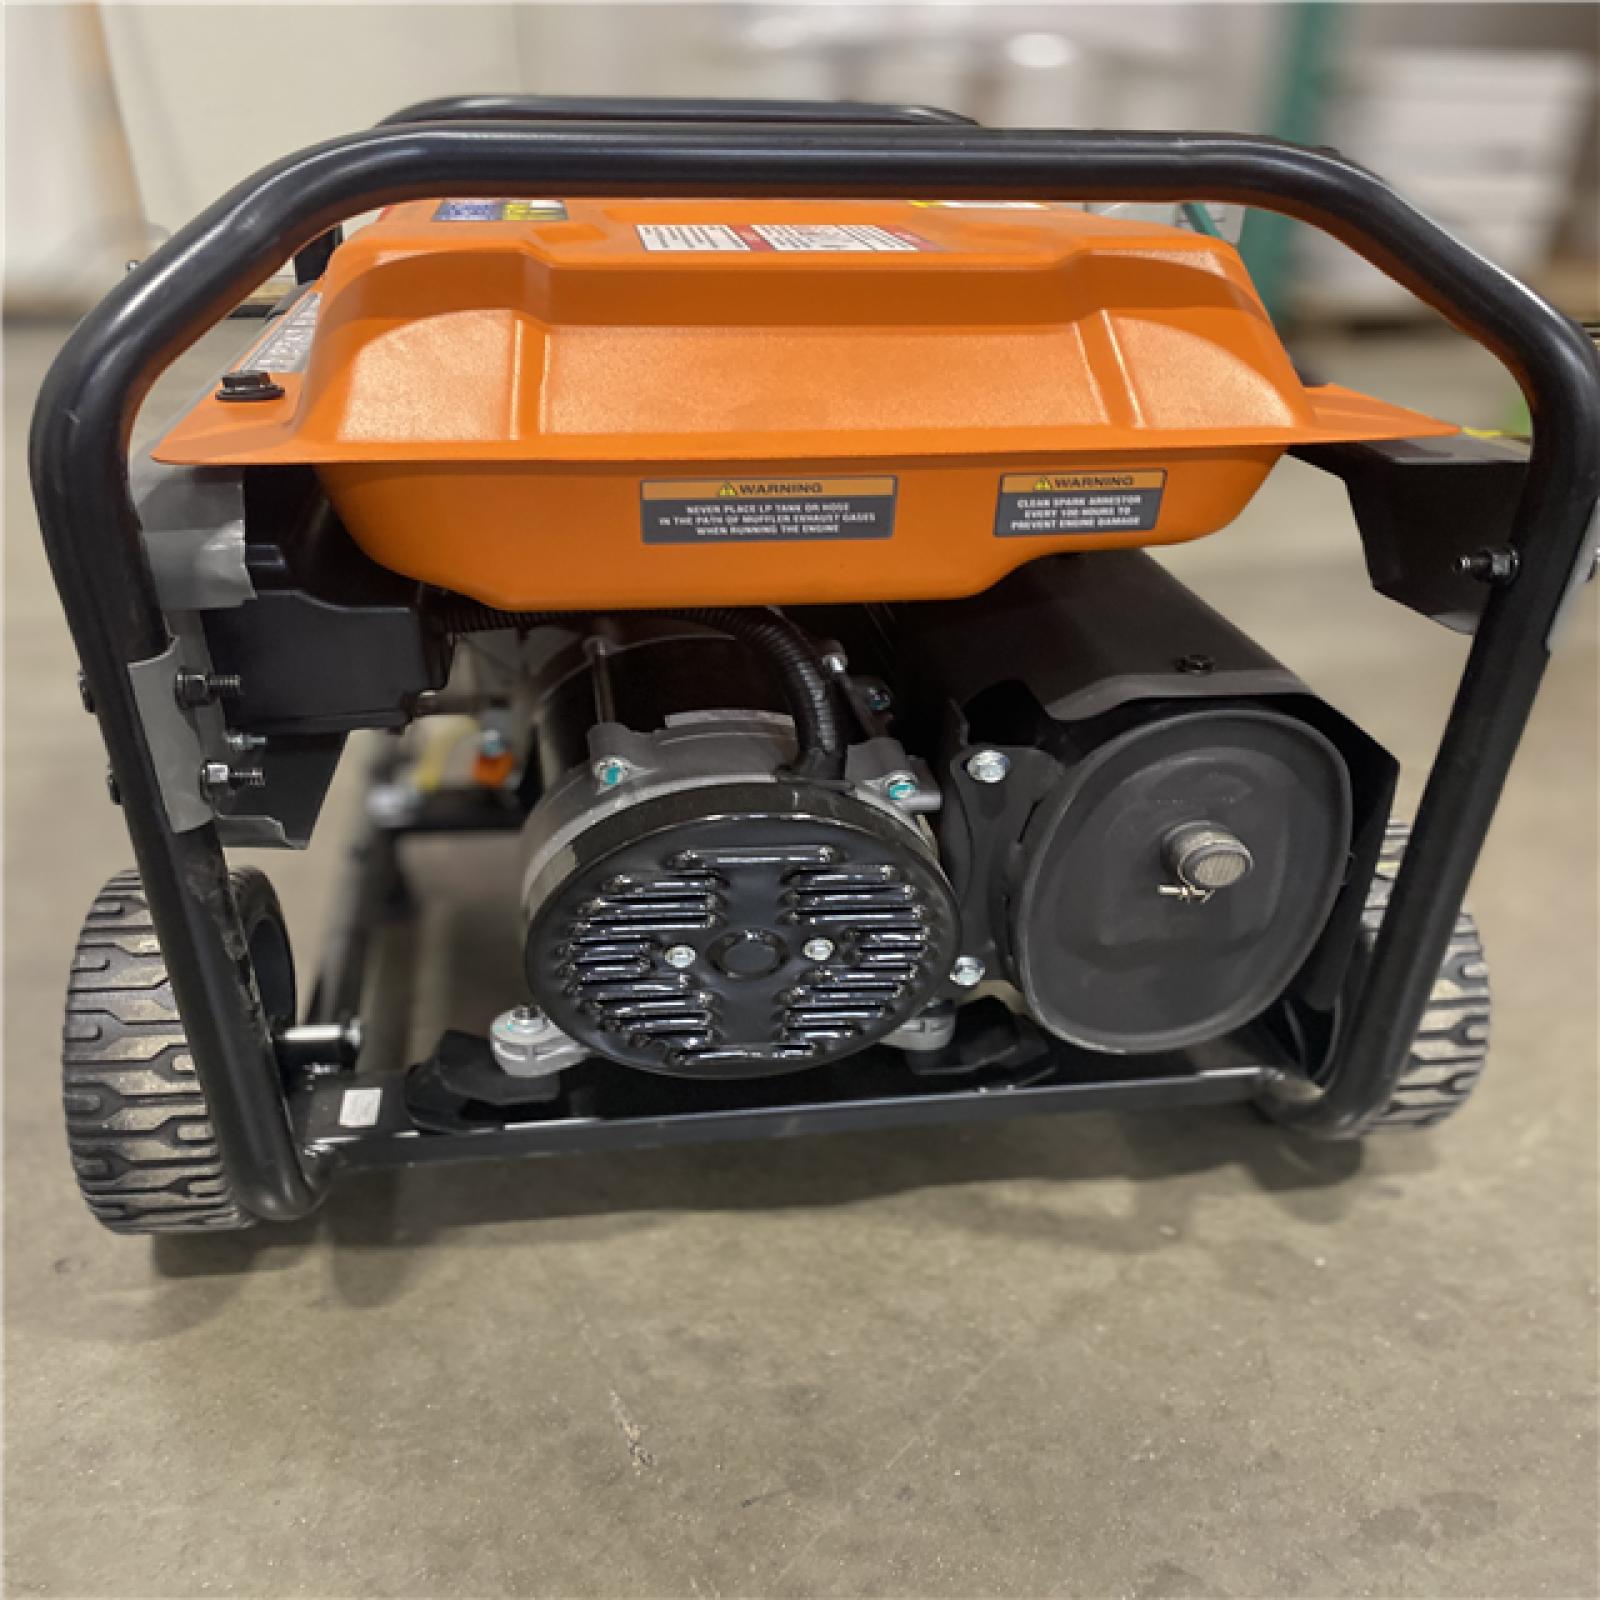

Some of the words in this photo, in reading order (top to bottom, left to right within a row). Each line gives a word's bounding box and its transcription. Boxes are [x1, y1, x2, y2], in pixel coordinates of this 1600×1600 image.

[1055, 477, 1134, 487] WARNING
[740, 483, 823, 494] WARNING
[1017, 498, 1051, 508] CLEAN
[1053, 497, 1086, 506] SPARK
[1089, 495, 1141, 506] ARRESTOR
[686, 504, 721, 514] NEVER
[724, 504, 756, 513] PLACE
[775, 503, 801, 512] TANK
[804, 503, 819, 512] OR
[822, 502, 849, 511] HOSE
[1024, 509, 1058, 518] EVERY
[1082, 507, 1115, 516] HOURS
[1117, 506, 1131, 515] TO
[659, 516, 671, 525] IN
[674, 516, 693, 525] THE
[695, 515, 723, 524] PATH
[725, 515, 738, 524] OF
[741, 514, 790, 523] MUFFLER
[793, 513, 840, 522] EXHAUST
[842, 512, 876, 522] GASES
[1011, 520, 1056, 530] PREVENT
[1059, 518, 1096, 528] ENGINE
[1097, 517, 1141, 526] DAMAGE
[696, 526, 729, 536] WHEN
[730, 525, 778, 535] RUNNING
[781, 524, 799, 534] THE
[802, 524, 839, 533] ENGINE
